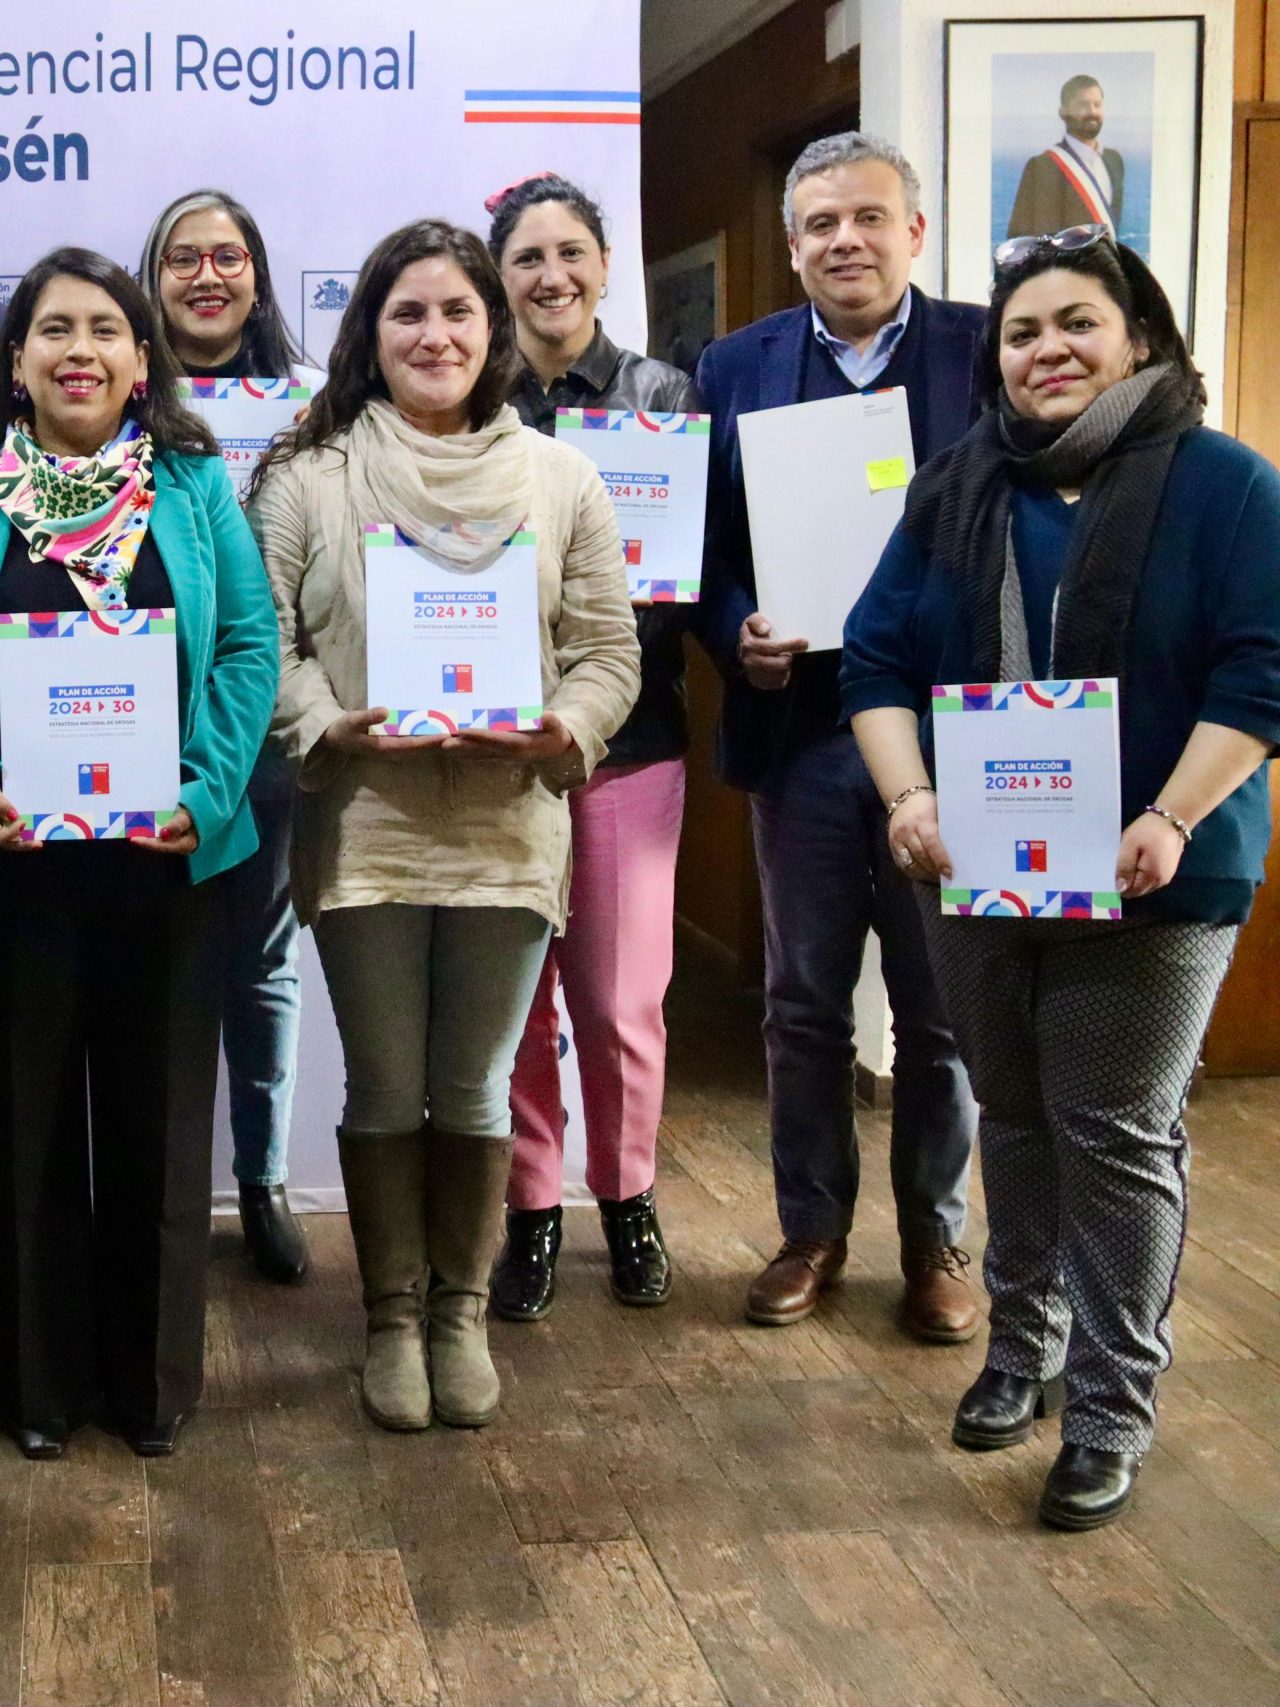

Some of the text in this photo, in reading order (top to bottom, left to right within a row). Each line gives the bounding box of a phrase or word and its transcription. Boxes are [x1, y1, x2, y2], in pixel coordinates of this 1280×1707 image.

[176, 29, 415, 106] Regional
[224, 451, 240, 461] 24
[604, 473, 663, 483] PLAN DE ACCIÓN
[604, 485, 669, 498] 024 30
[423, 592, 489, 601] PLAN DE ACCIÓN
[414, 606, 497, 618] 2024 30
[58, 686, 127, 696] PLAN DE ACCIÓN
[49, 700, 135, 715] 2024 30
[994, 761, 1064, 771] PLAN DE ACCIÓN
[985, 776, 1072, 789] 2024 30
